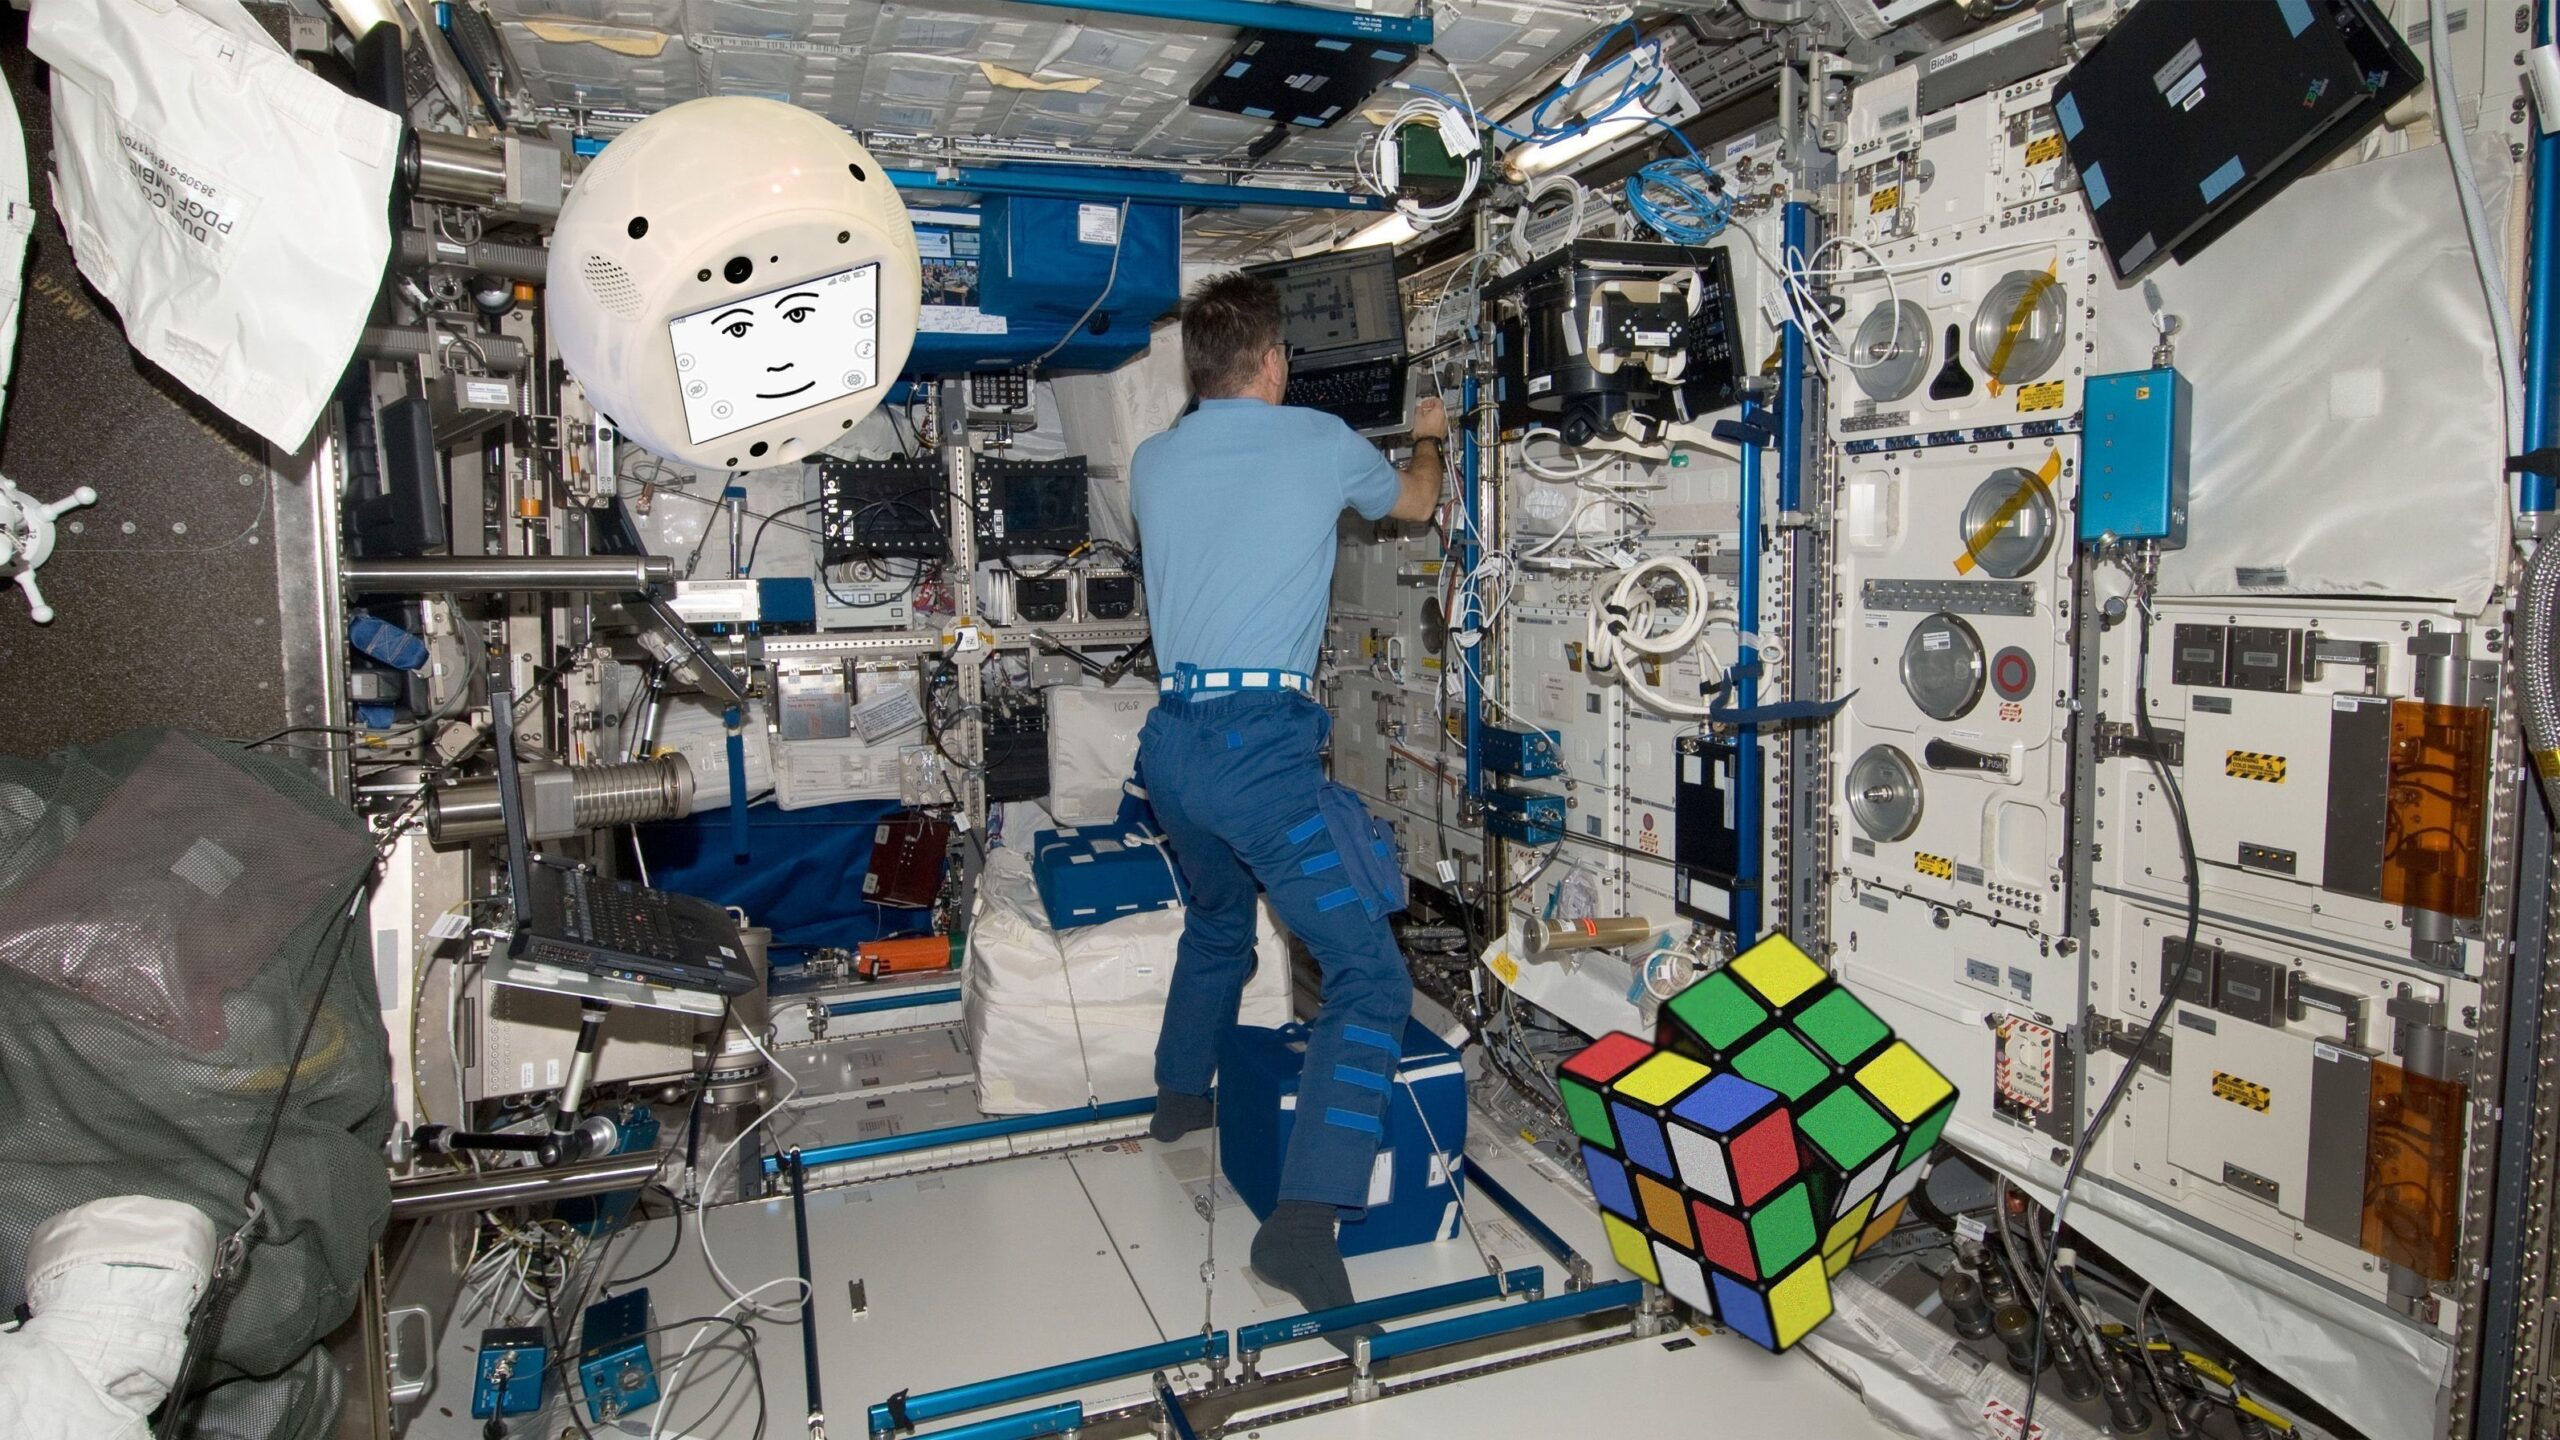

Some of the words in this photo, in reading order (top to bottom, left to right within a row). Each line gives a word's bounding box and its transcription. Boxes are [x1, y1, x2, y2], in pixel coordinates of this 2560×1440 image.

[1930, 53, 1958, 70] Biolab
[1582, 200, 1603, 215] ODULES
[178, 198, 234, 235] PDGF
[1113, 701, 1140, 712] 1068
[1989, 757, 2003, 769] PUSH
[1992, 1411, 2023, 1434] EMERGENC
